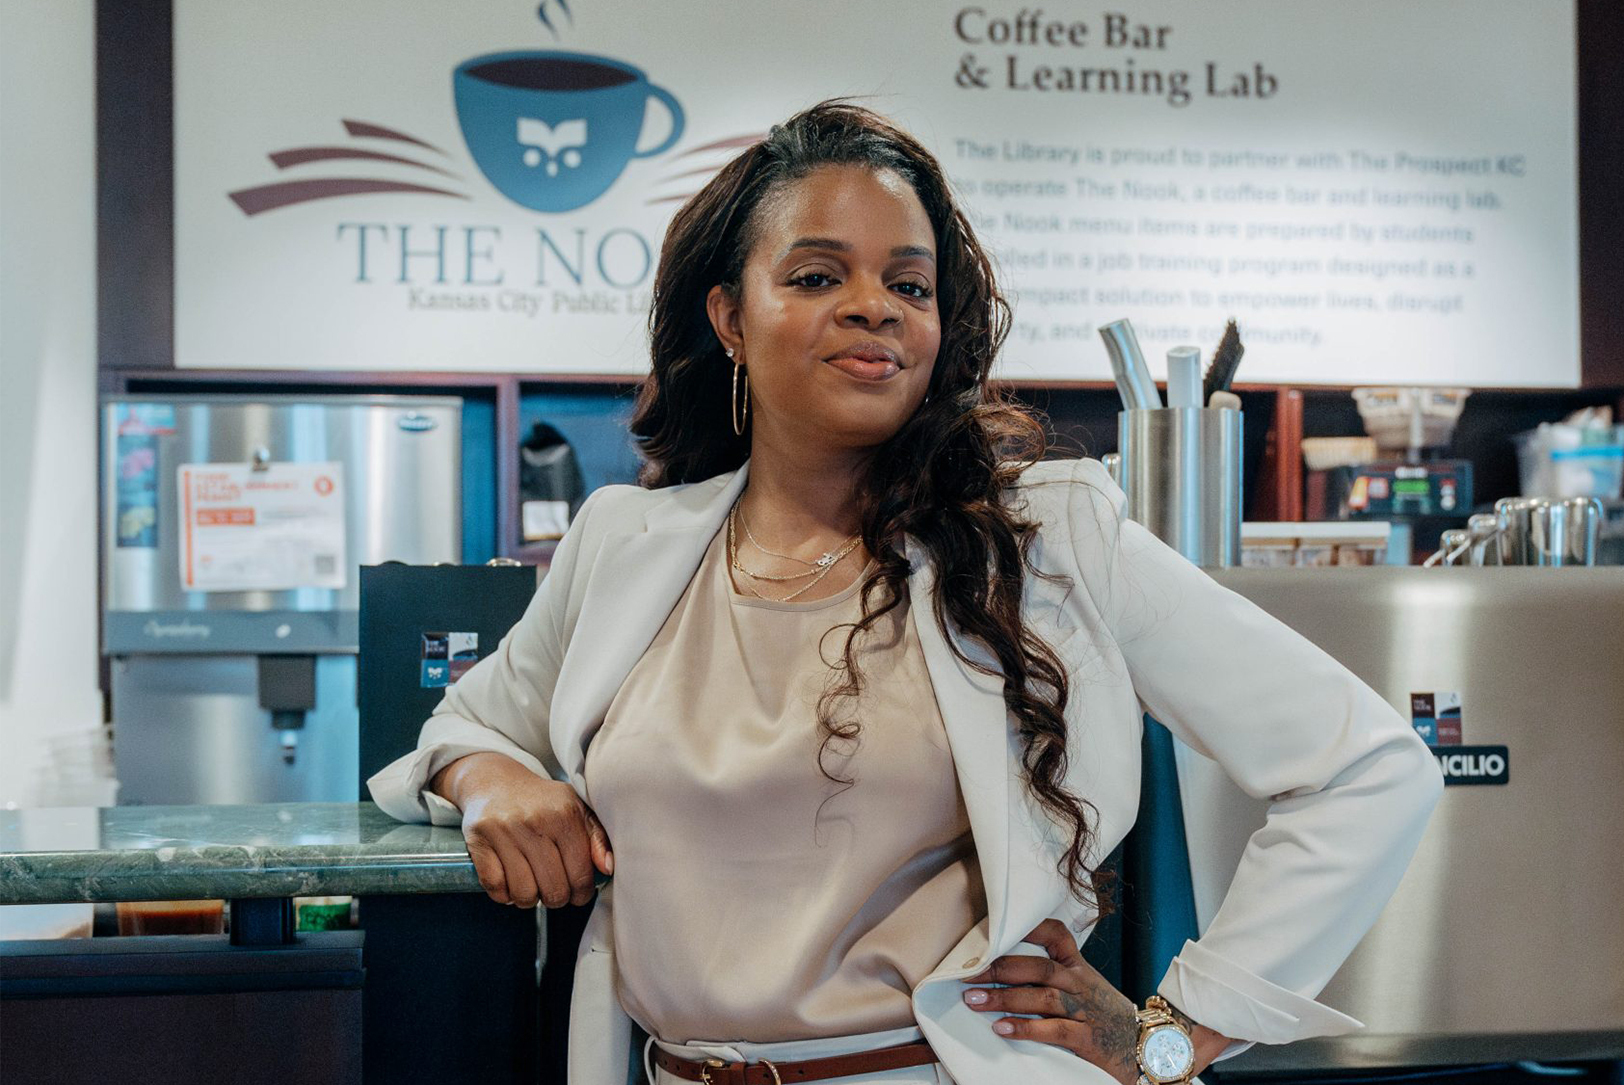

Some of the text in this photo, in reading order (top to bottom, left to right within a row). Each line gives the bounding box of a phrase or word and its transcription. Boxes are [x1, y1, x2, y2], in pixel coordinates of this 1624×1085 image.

[954, 6, 1172, 50] Coffee Bar
[955, 53, 1278, 108] & Learning Lab
[956, 140, 997, 161] The
[1001, 141, 1077, 166] Library
[1086, 145, 1103, 163] is
[1110, 146, 1176, 168] proud
[1181, 147, 1204, 166] to
[1208, 149, 1289, 170] partner
[1296, 151, 1342, 169] with
[1348, 149, 1389, 170] The
[1394, 151, 1491, 177] Prospect
[980, 179, 1066, 199] operate
[1075, 177, 1116, 198] The
[1210, 183, 1281, 203] coffee
[1284, 185, 1320, 205] bar
[1326, 188, 1367, 206] and
[1371, 188, 1459, 212] learning
[1003, 213, 1061, 232] Nook
[1068, 217, 1132, 234] menu
[1138, 217, 1199, 235] items
[1205, 219, 1240, 236] are
[1245, 222, 1344, 244] prepared
[1348, 223, 1373, 243] by
[1378, 224, 1475, 244] students
[338, 221, 504, 287] THE
[1051, 251, 1076, 268] in
[1097, 252, 1134, 274] job
[1137, 254, 1223, 278] training
[1227, 257, 1322, 279] program
[1326, 256, 1427, 281] designed
[1432, 261, 1458, 278] as
[407, 288, 488, 311] Kansas
[498, 291, 541, 319] City
[552, 293, 620, 315] Public
[1095, 286, 1187, 306] solution
[1190, 289, 1213, 307] to
[1217, 292, 1320, 312] empower
[1050, 322, 1092, 341] and
